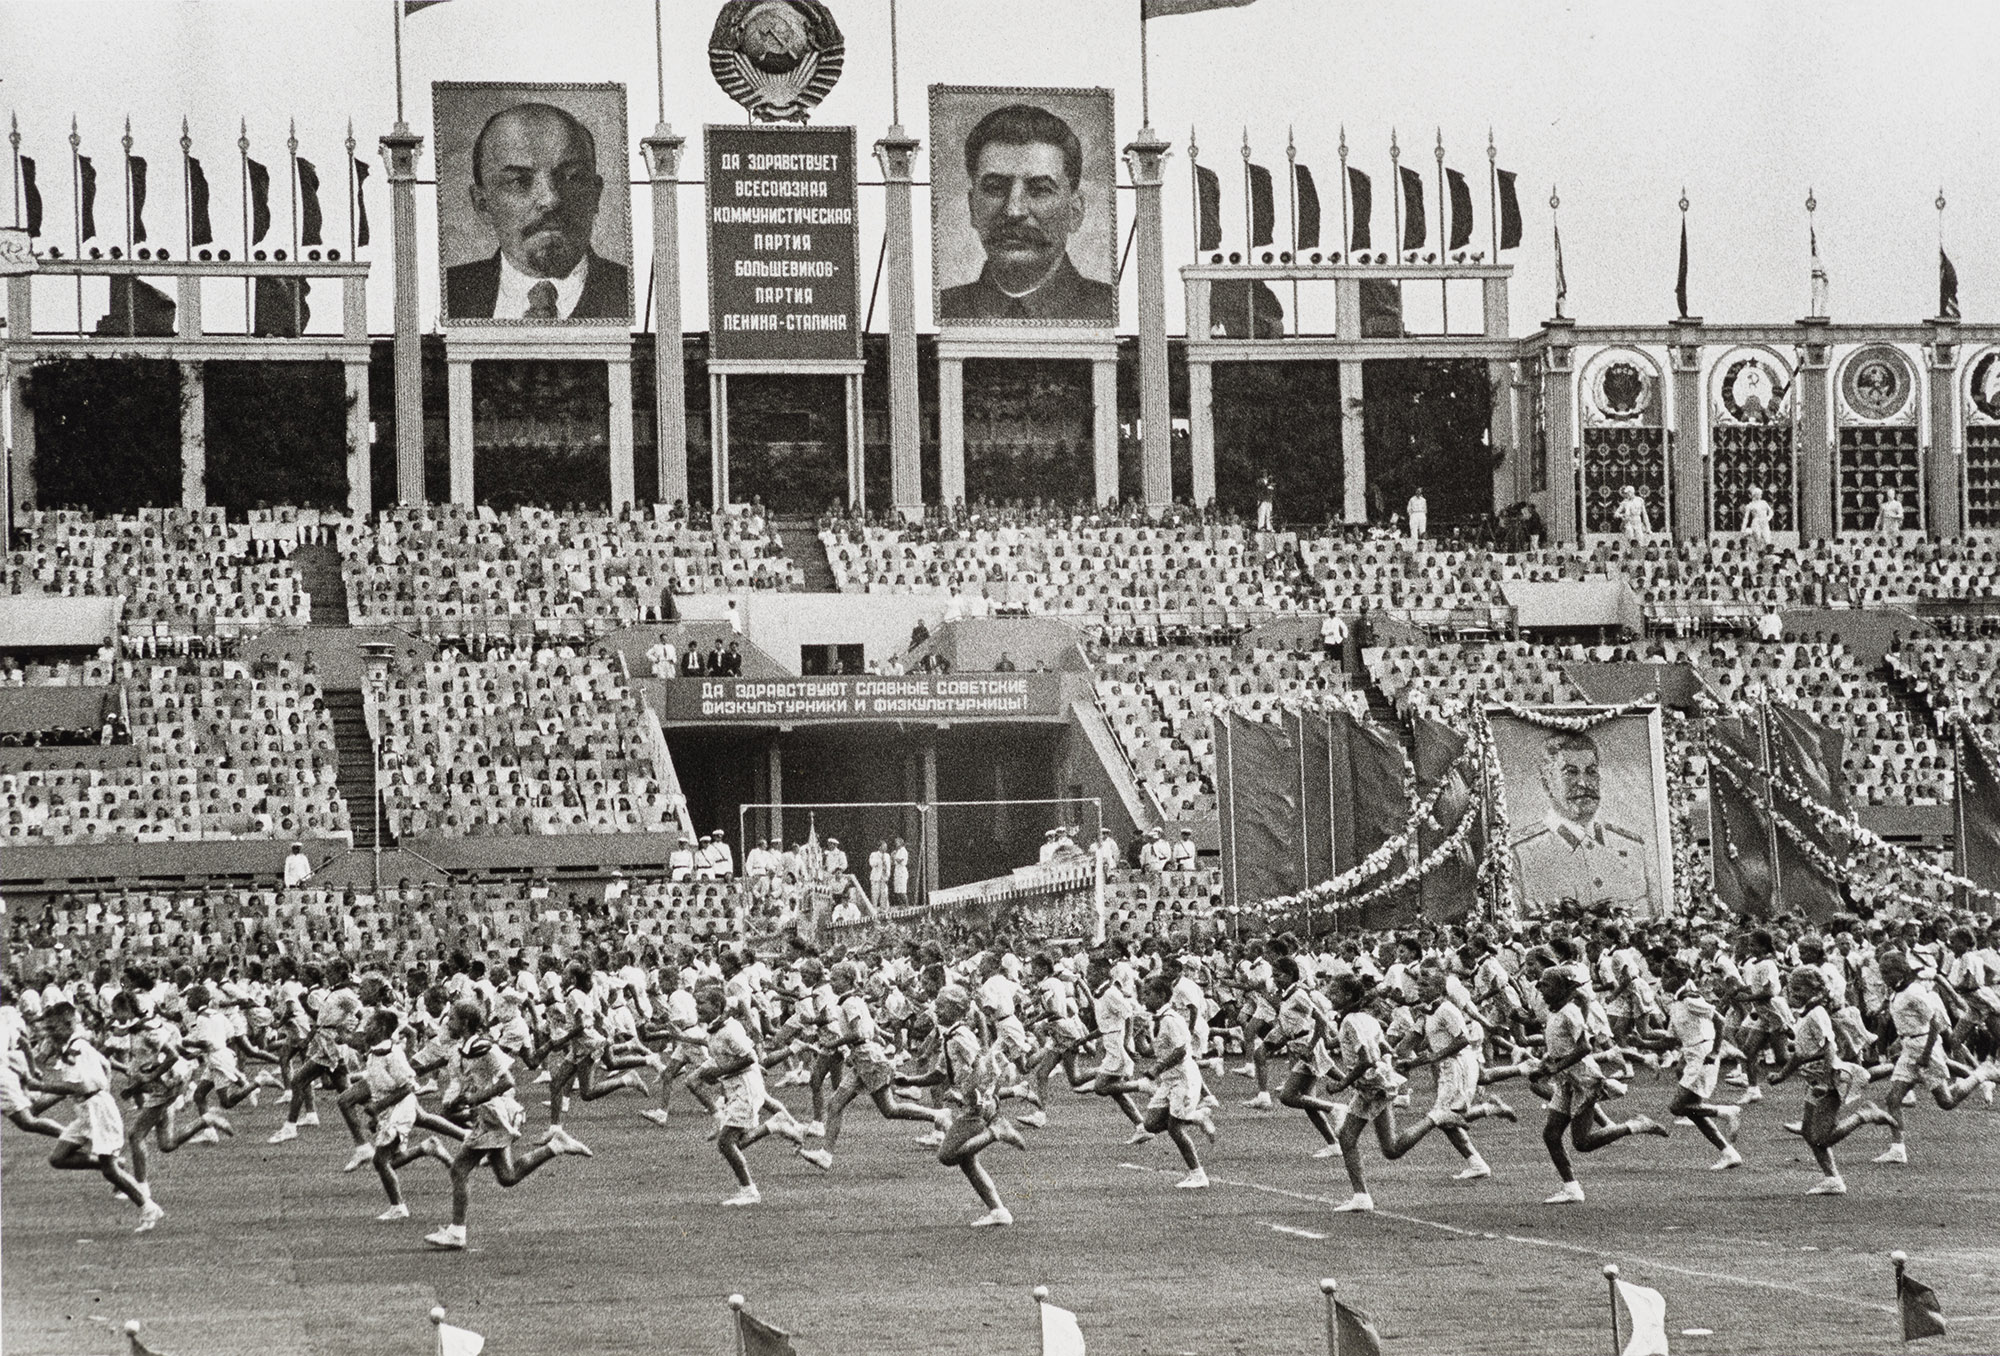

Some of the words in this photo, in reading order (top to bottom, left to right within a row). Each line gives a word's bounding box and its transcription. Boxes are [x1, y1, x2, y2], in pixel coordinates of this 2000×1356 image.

[721, 154, 740, 170] ДА
[748, 154, 838, 171] ЗДРАВСТВУЕТ
[735, 180, 828, 197] ВСЕСОЮЗНАЯ
[713, 207, 852, 224] КОММУНИСТИЧЕСКАЯ
[754, 234, 811, 250] ПАРТИЯ
[755, 287, 813, 304] ПАРТИЯ
[735, 682, 848, 699] ЗДРАВСТВУЮТ
[855, 681, 929, 695] СЛАВНЫЕ
[936, 679, 1028, 695] СОВЕТСКИЕ
[702, 699, 847, 715] ФИЗКУЛЬТУРНИКИ
[854, 699, 866, 711] И
[874, 695, 1028, 712] ФИЗКУЛЬТУРНИЦЫ!
